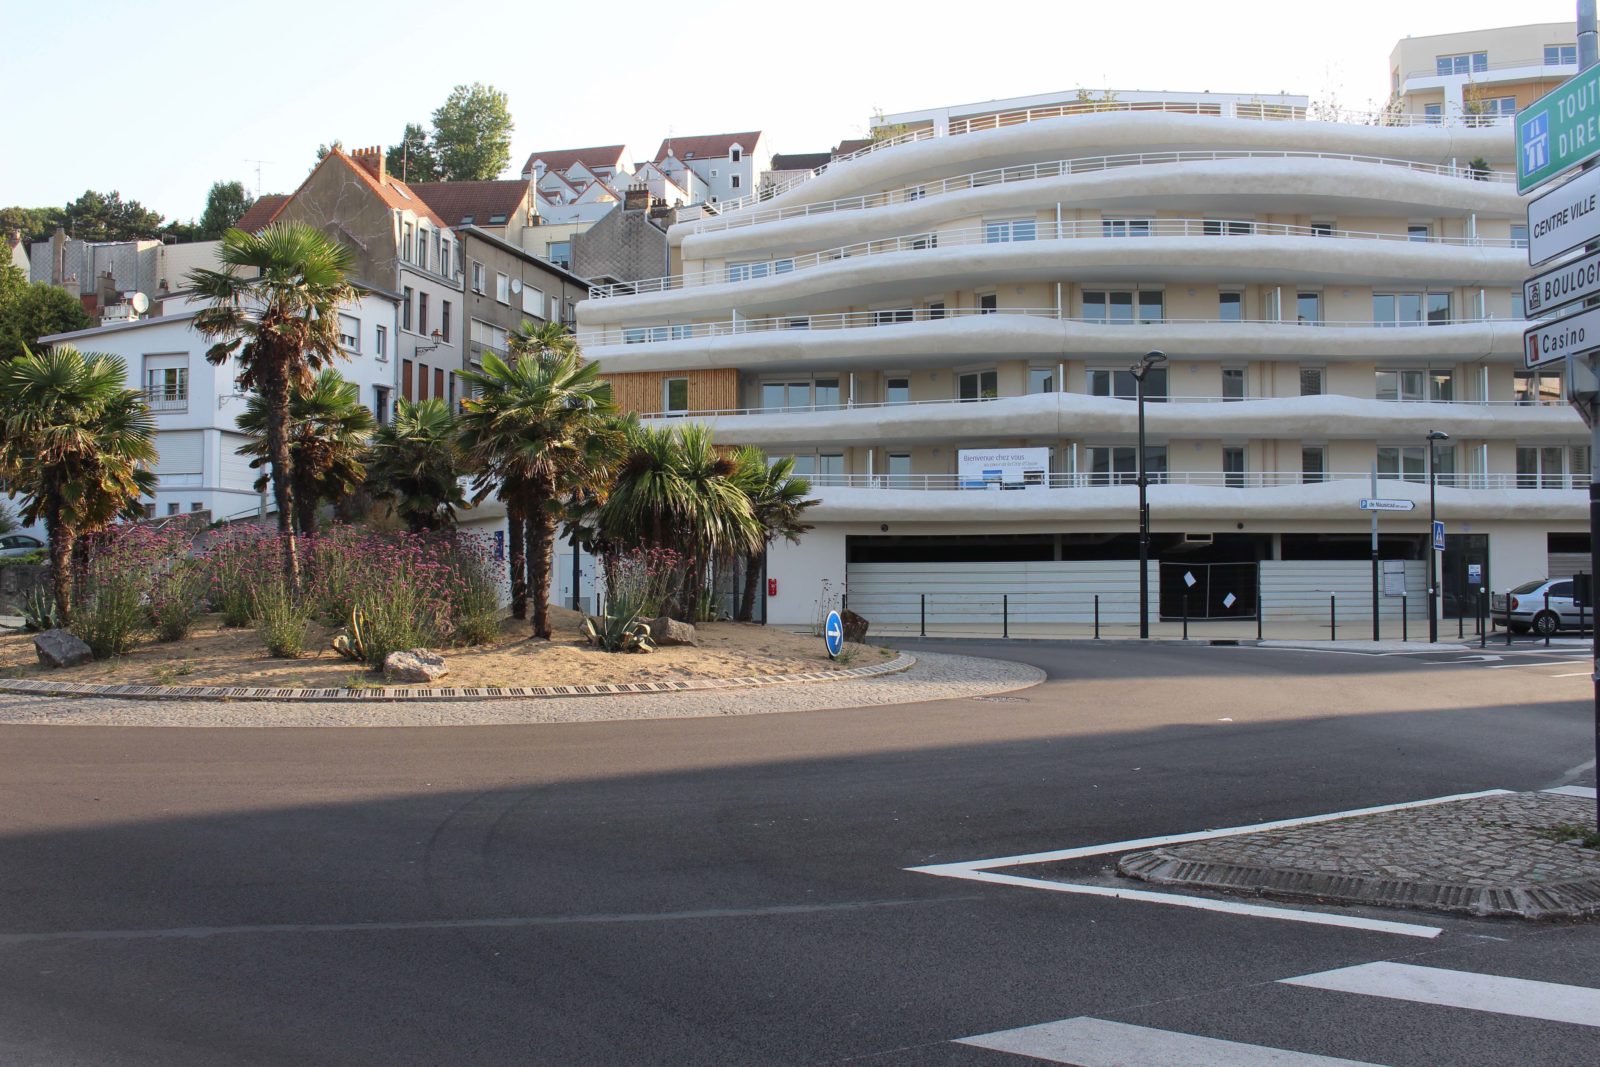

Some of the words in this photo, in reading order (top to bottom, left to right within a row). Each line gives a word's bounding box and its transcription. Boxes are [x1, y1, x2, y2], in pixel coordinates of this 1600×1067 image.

[1558, 75, 1600, 124] TOUT
[1559, 113, 1600, 159] DIRE
[1533, 207, 1569, 239] CENTRE
[1570, 194, 1596, 221] VILLE
[1542, 327, 1585, 354] Casino
